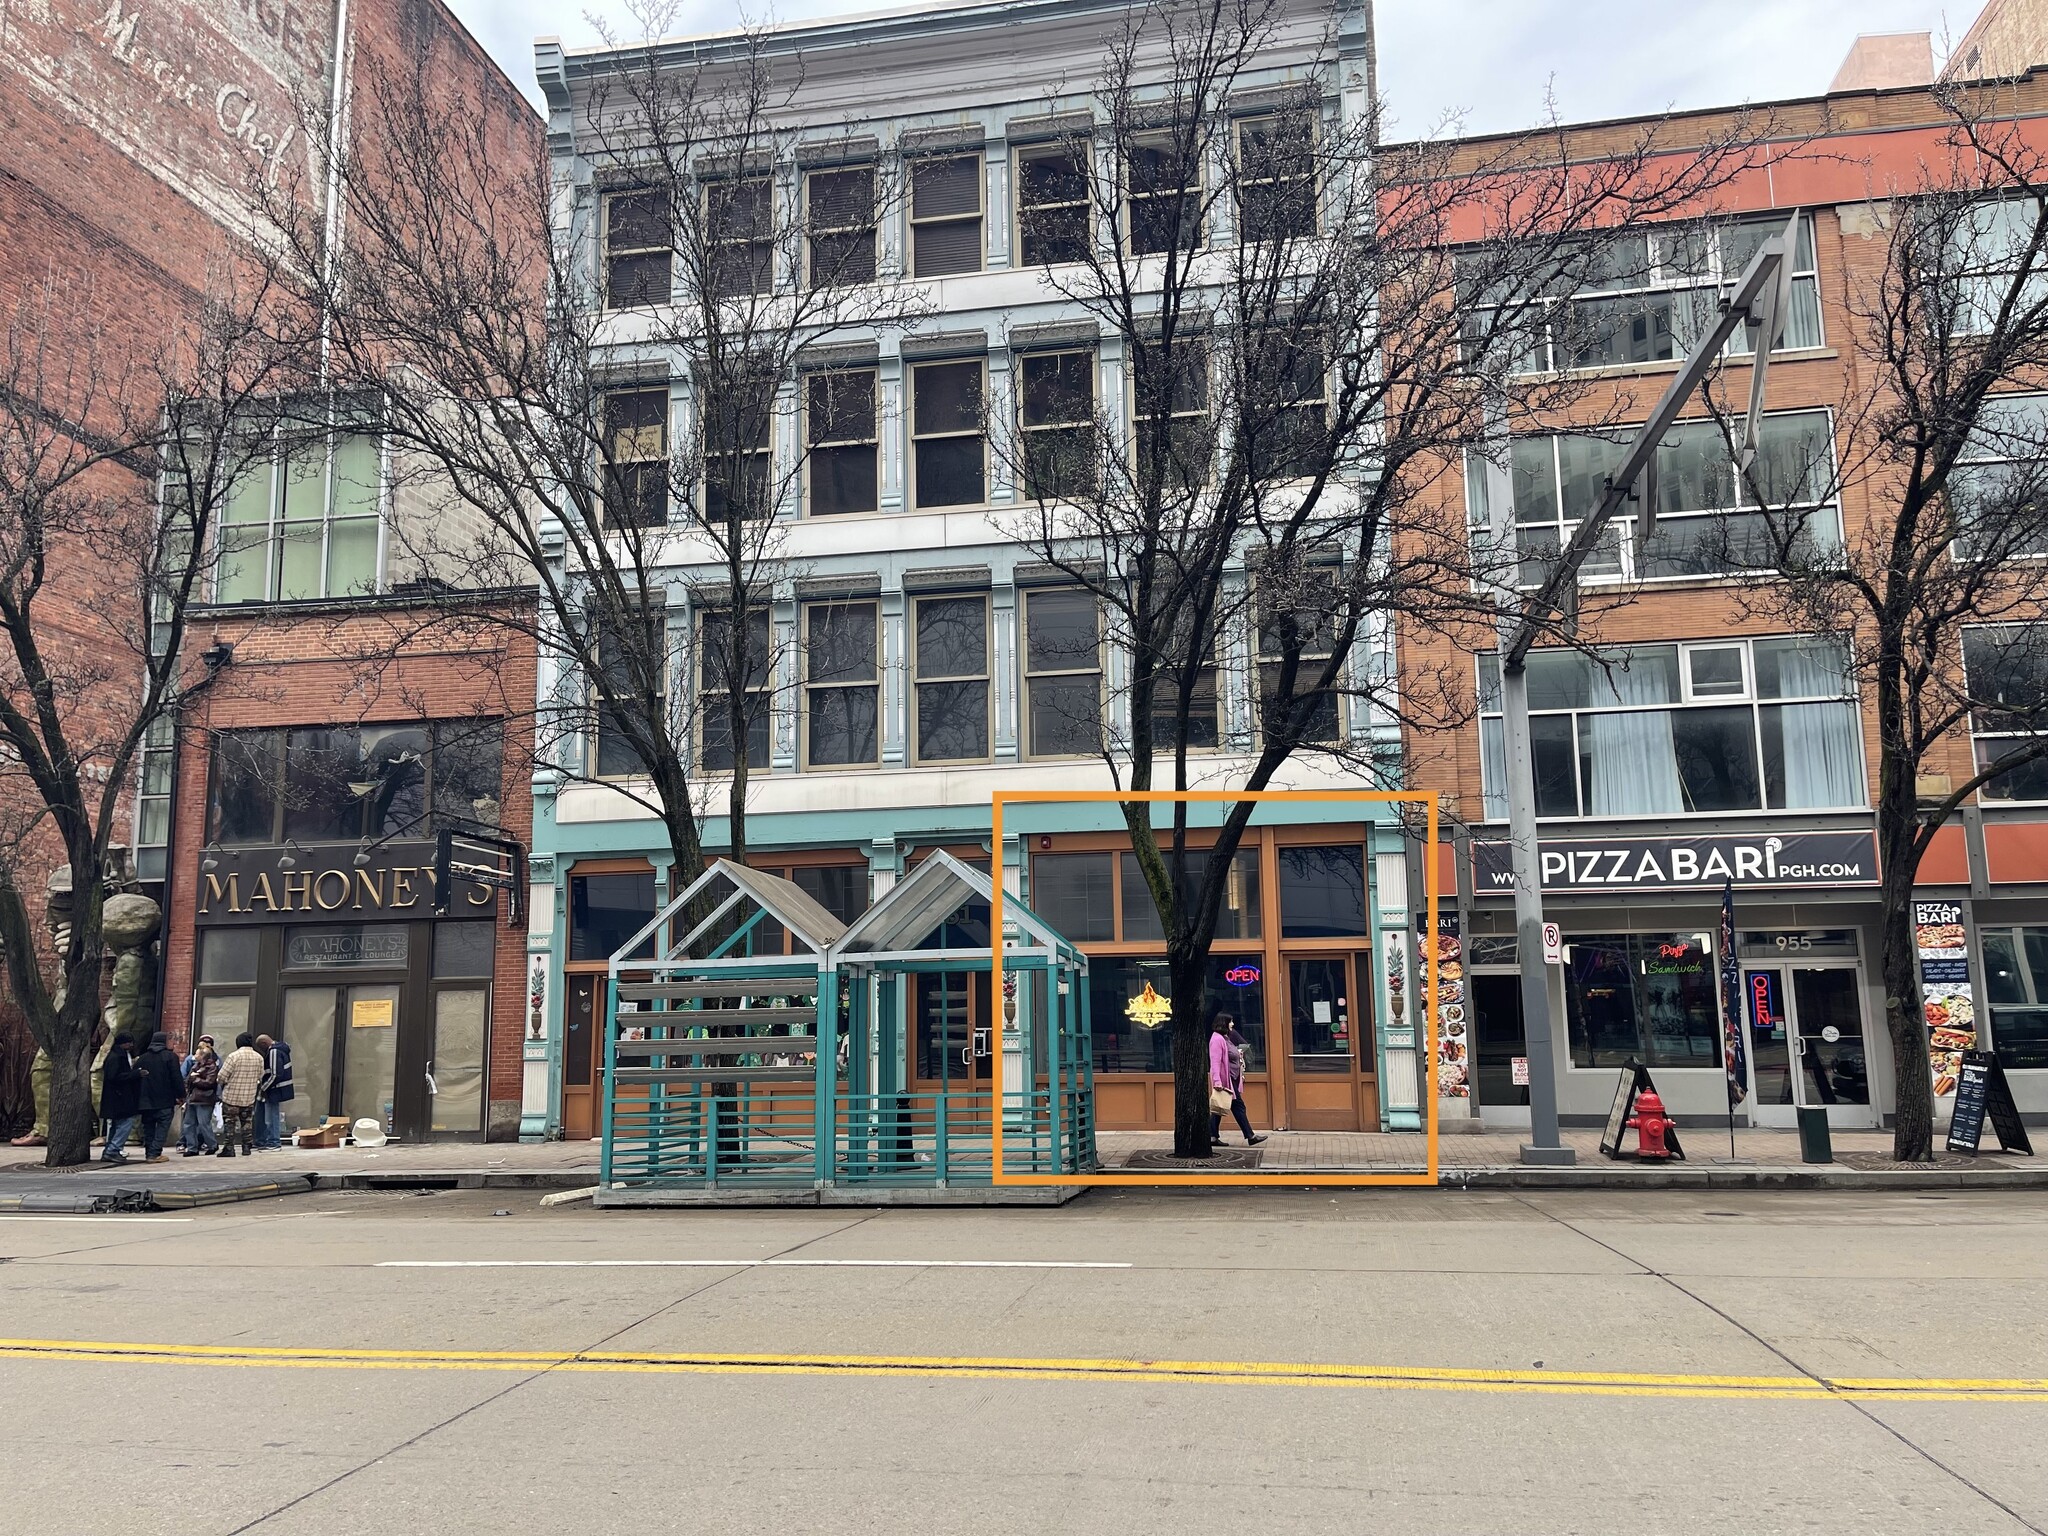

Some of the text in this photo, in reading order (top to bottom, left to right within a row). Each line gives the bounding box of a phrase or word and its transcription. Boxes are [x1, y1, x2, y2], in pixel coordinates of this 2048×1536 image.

[215, 82, 296, 188] Chef
[1916, 903, 1951, 912] PIZZA
[1917, 911, 1957, 924] BARI
[1776, 936, 1812, 951] 955
[304, 953, 353, 961] RESTAURANT
[364, 951, 397, 960] LOUNGE
[1648, 961, 1704, 974] Sandwich
[1225, 969, 1259, 982] OPEN
[1753, 976, 1770, 1025] OPEN
